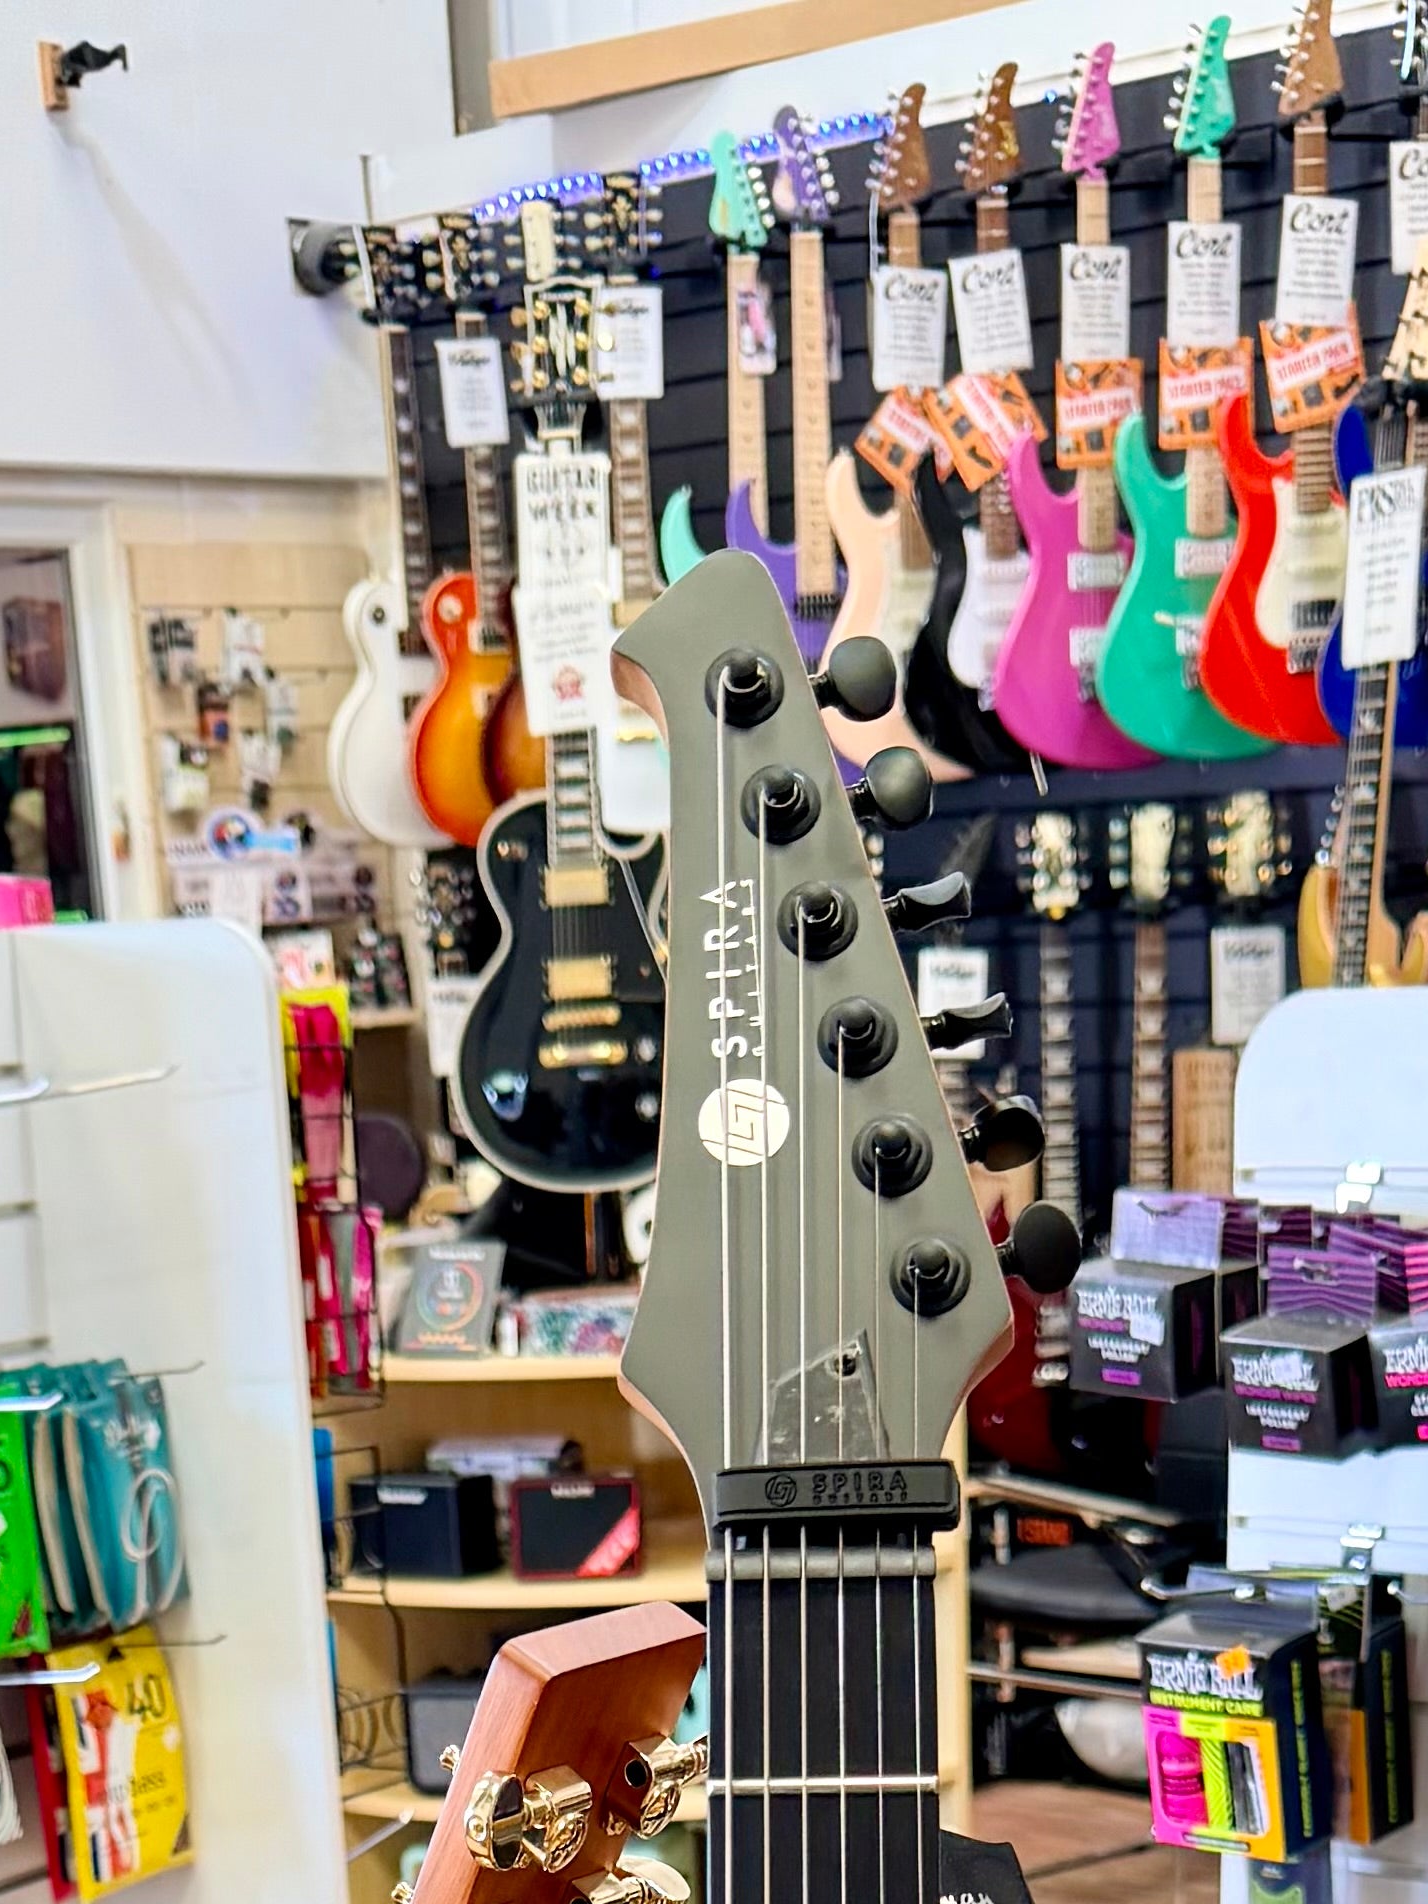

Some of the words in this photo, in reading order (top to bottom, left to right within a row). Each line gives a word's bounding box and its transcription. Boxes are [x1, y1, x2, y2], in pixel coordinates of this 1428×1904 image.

[1290, 202, 1349, 234] Cort
[1176, 228, 1232, 259] Cort
[700, 880, 747, 1059] SPIRA
[811, 1469, 908, 1495] SPIRA
[1147, 1650, 1209, 1697] ERNIE
[125, 1673, 167, 1722] 40
